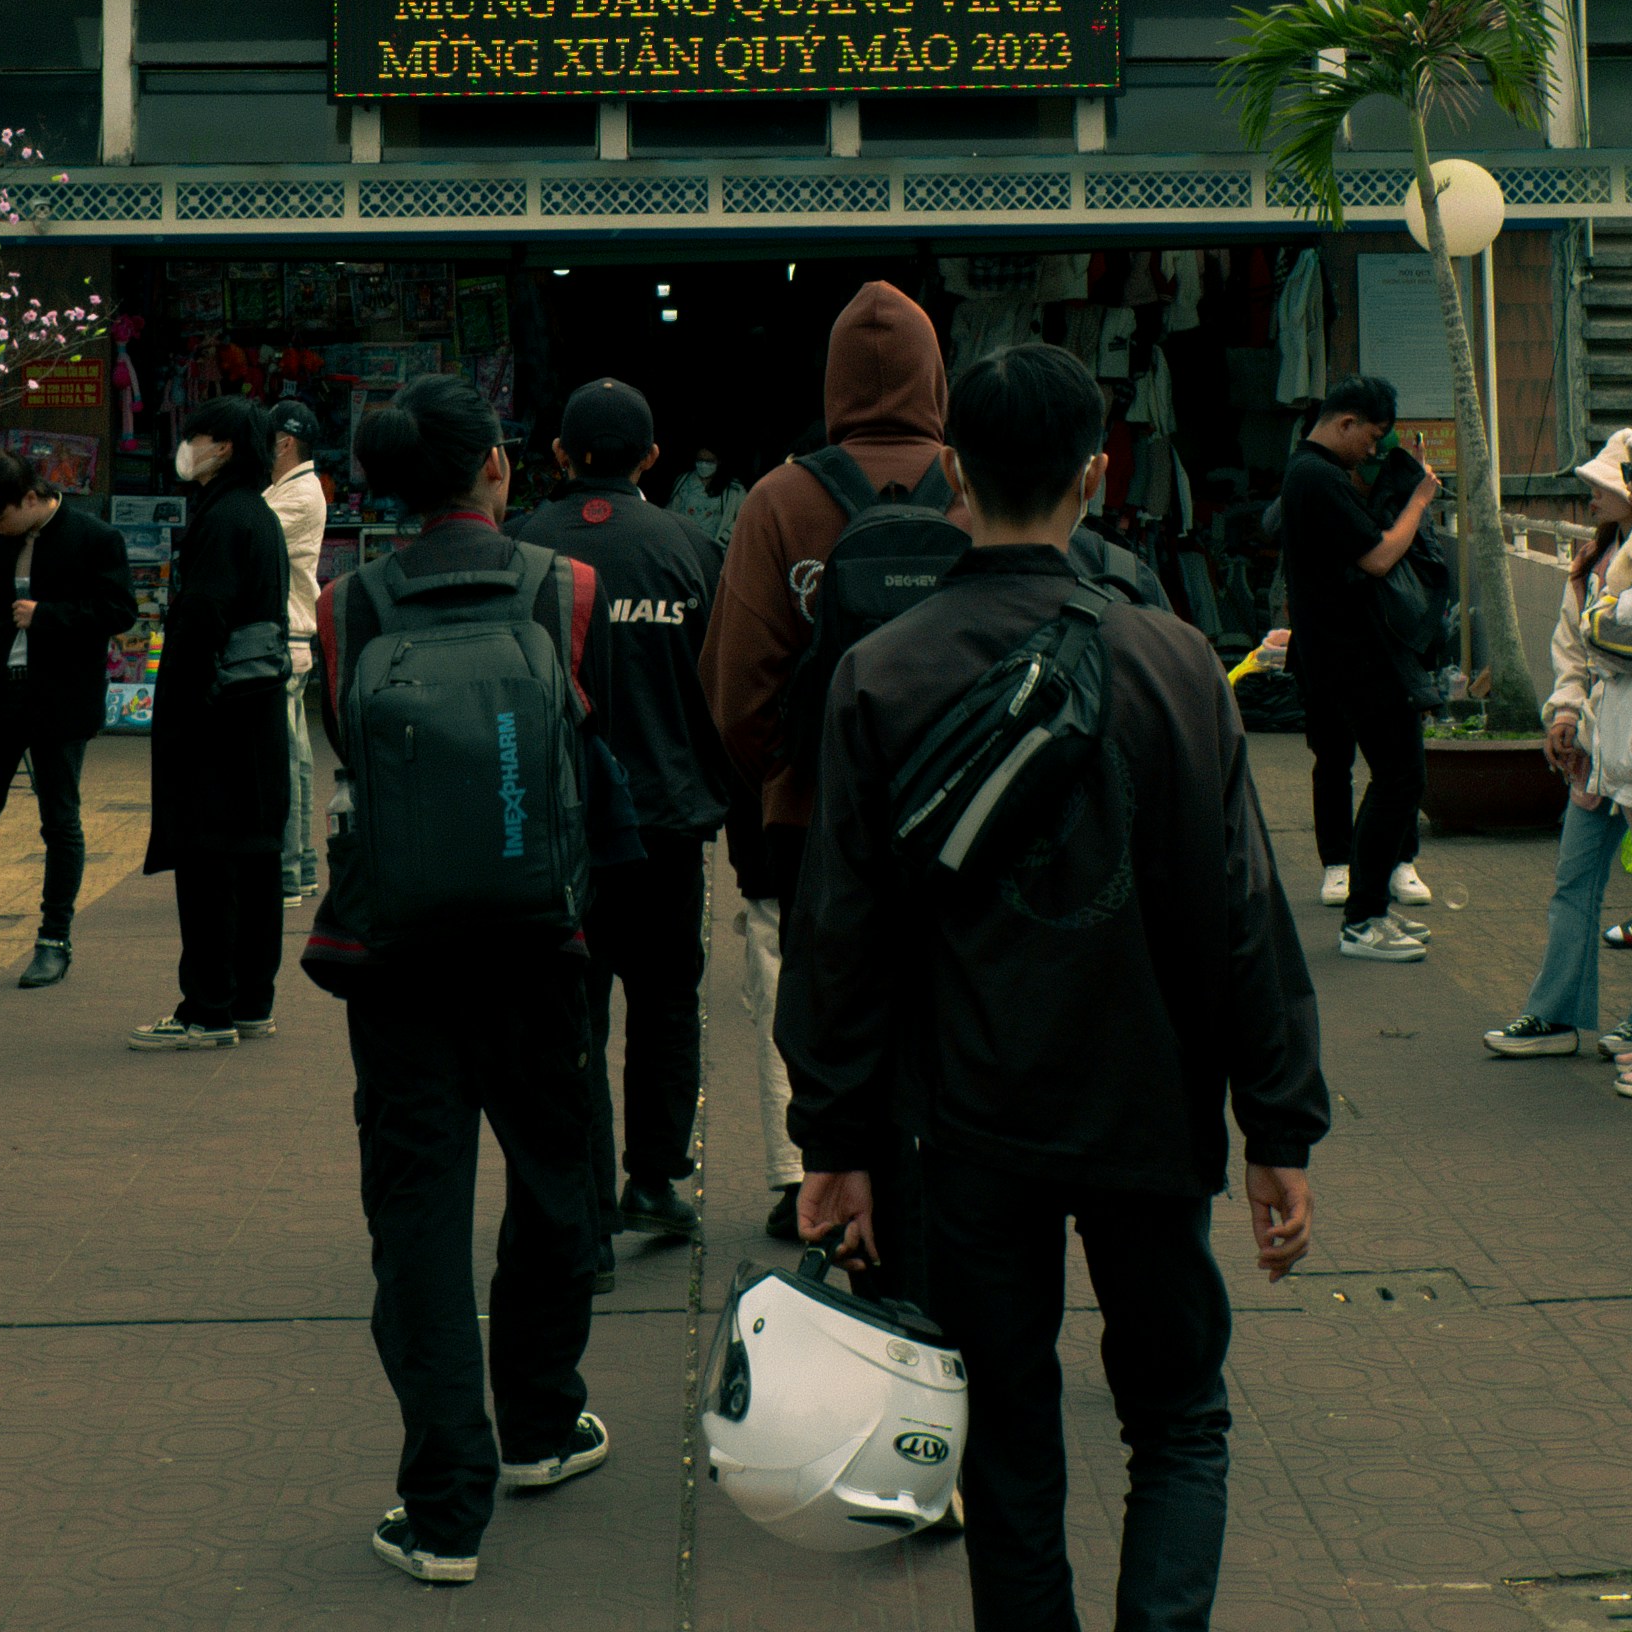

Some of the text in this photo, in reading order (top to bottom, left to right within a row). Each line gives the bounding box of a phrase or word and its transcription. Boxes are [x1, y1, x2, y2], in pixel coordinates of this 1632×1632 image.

[378, 23, 1074, 79] MỪNG XUÂN QUÝ MÃO 2023
[608, 597, 687, 626] NIALS
[496, 710, 529, 860] IMEXPHARM
